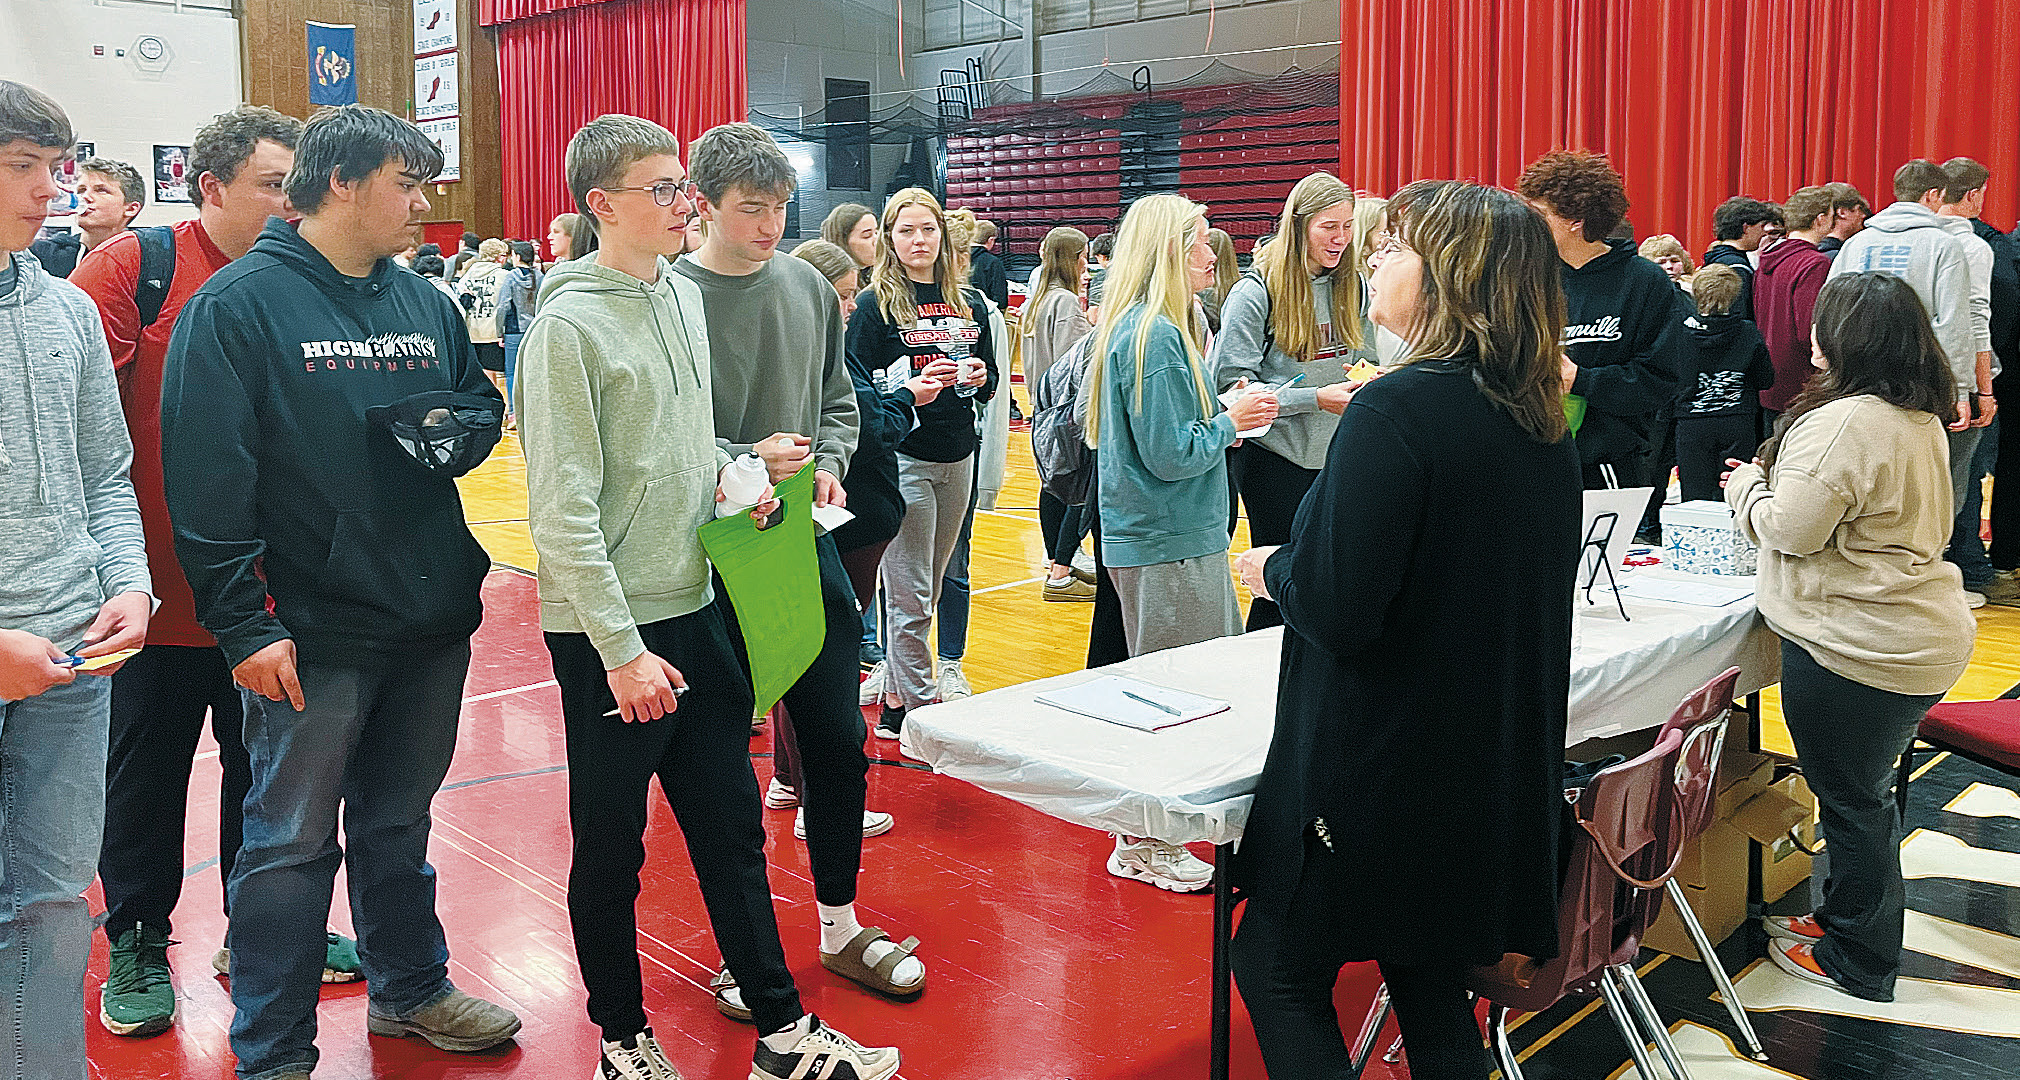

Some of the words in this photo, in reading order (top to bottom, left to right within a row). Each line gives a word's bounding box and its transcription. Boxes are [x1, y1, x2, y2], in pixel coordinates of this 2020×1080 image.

[301, 340, 372, 358] HIGH
[366, 332, 436, 358] PLAINS
[306, 359, 440, 372] EQUIPMENT
[914, 354, 946, 370] RO
